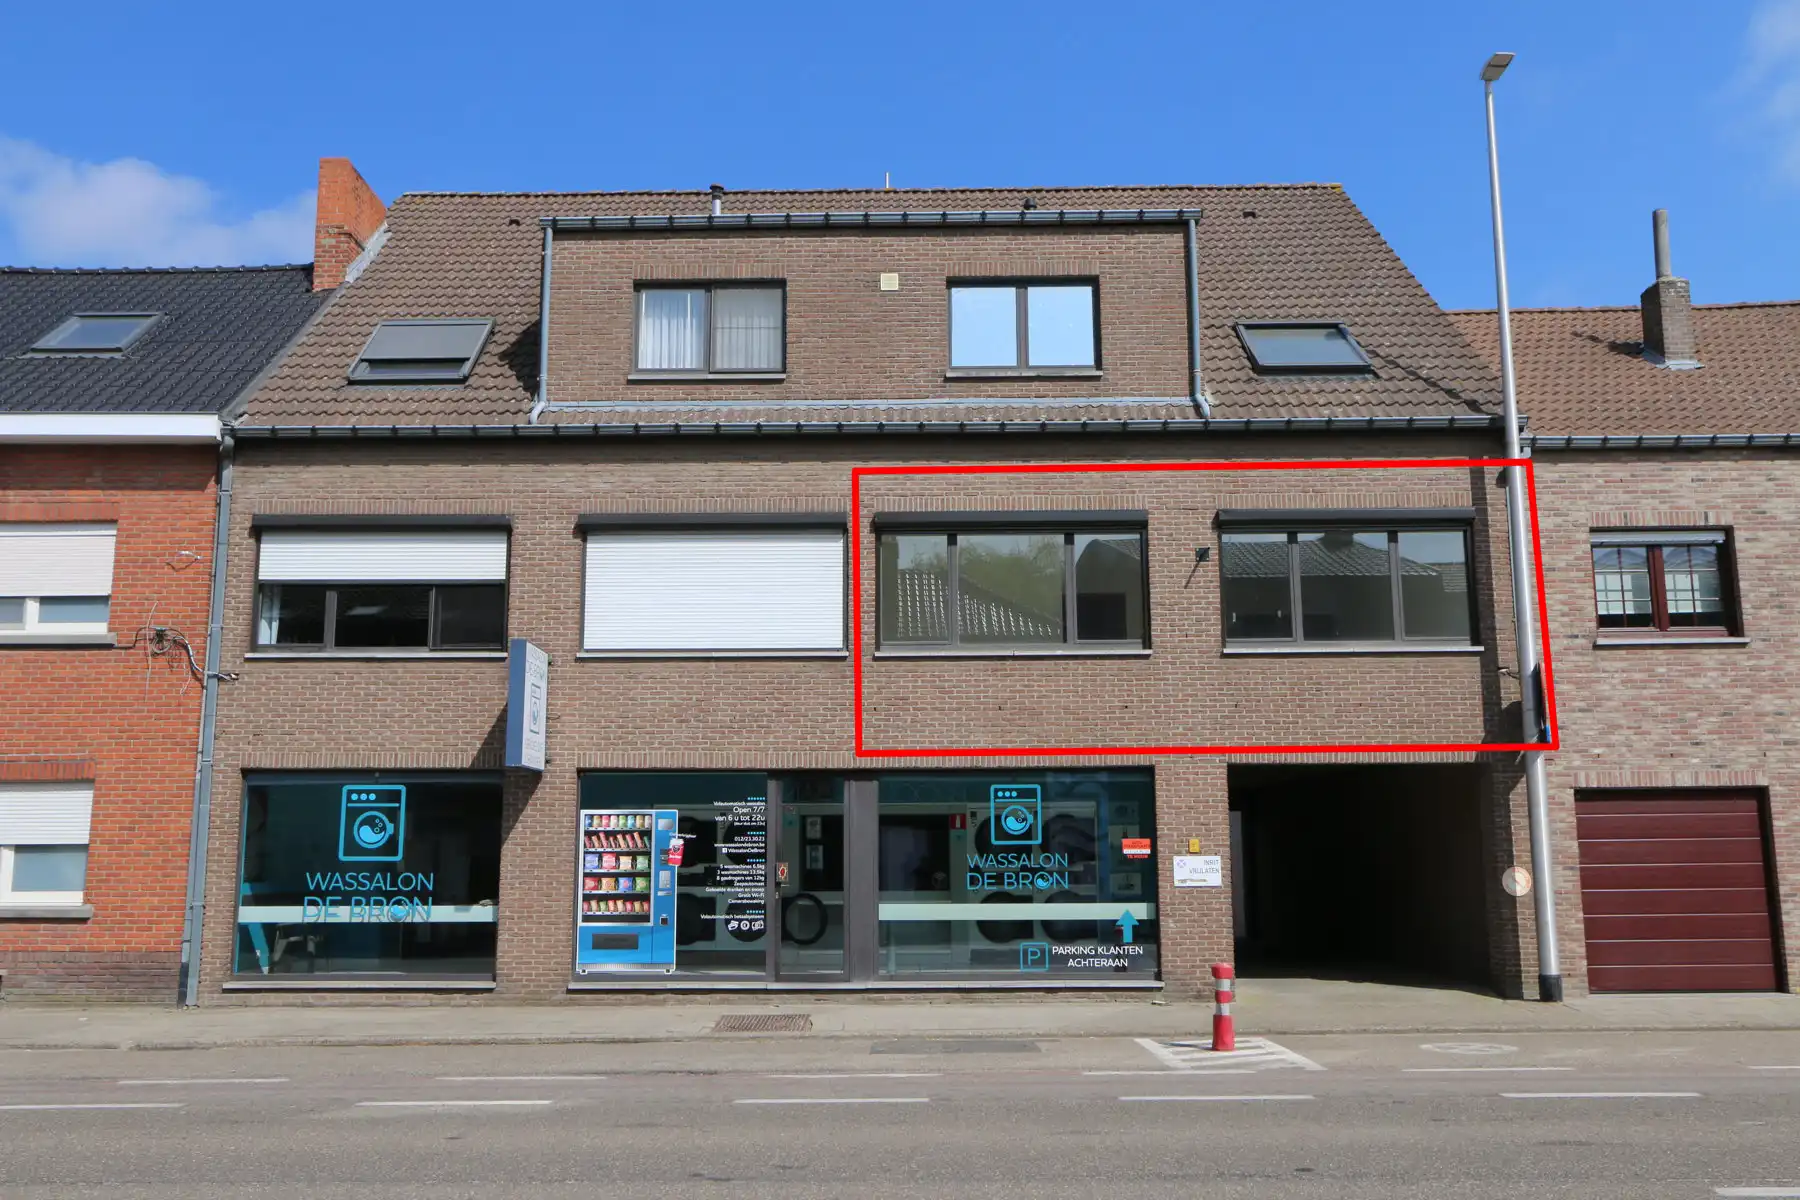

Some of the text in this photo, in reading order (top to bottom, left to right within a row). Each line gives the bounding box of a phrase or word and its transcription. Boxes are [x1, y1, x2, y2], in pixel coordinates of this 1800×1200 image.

[733, 806, 752, 814] Open
[966, 852, 1068, 869] WASSALON
[306, 872, 434, 891] WASSALON
[966, 871, 1069, 890] DE BRON
[303, 895, 433, 919] DE BRON
[1027, 947, 1041, 967] P
[1052, 946, 1143, 955] PARKING KLANTEN
[1067, 958, 1128, 967] ACHTERAAN
